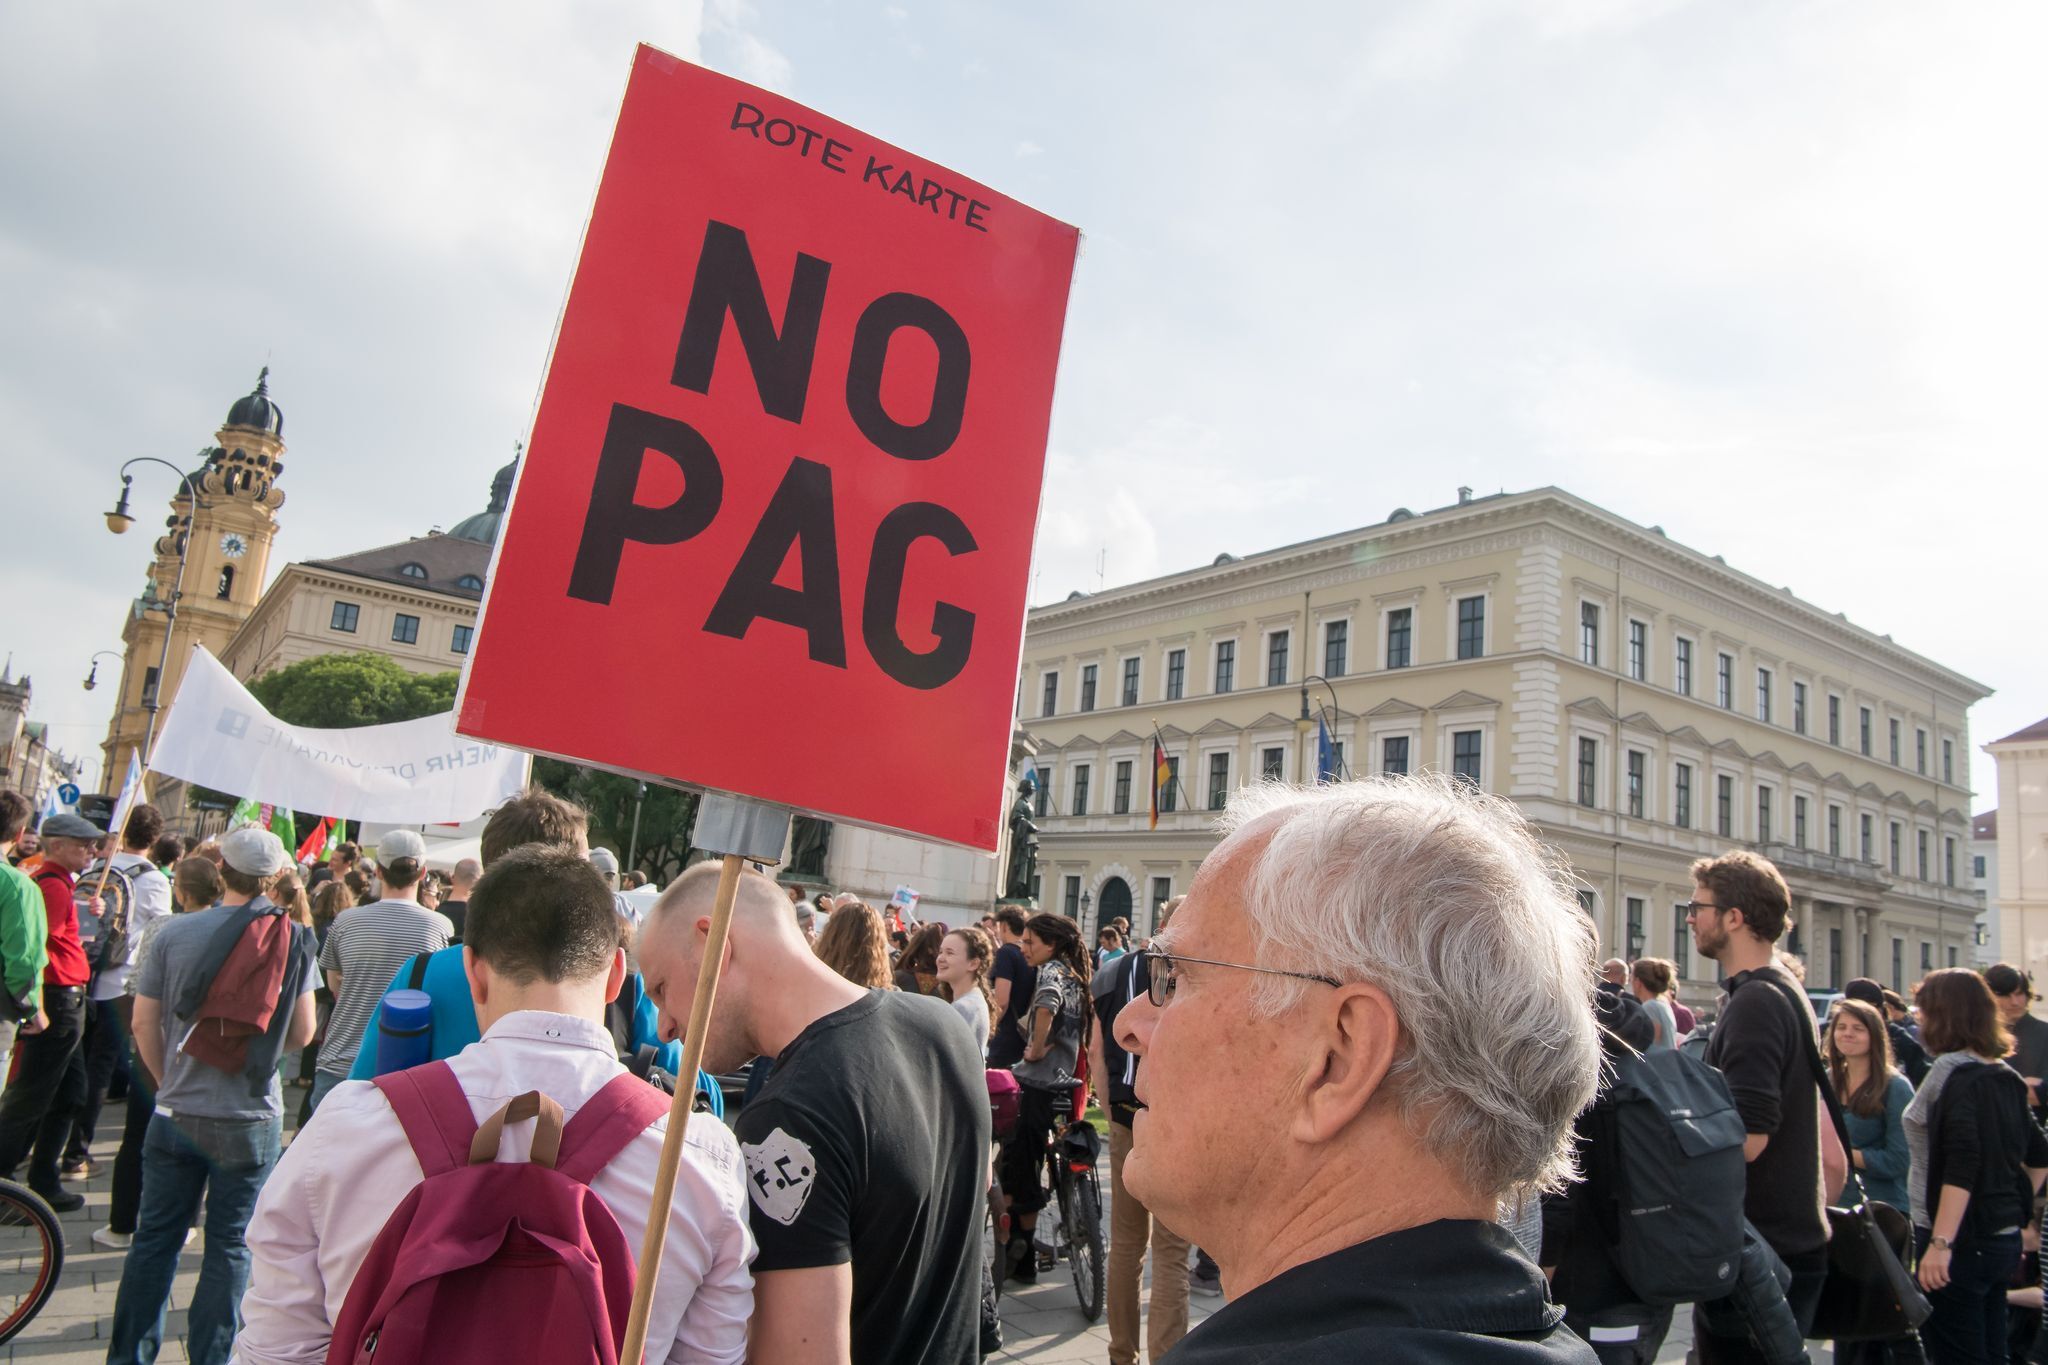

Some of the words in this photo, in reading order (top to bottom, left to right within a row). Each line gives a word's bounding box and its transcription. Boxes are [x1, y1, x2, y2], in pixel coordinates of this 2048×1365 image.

[730, 102, 853, 174] ROTE
[863, 155, 991, 233] KARTE
[670, 219, 972, 461] NO
[566, 401, 979, 691] PAG
